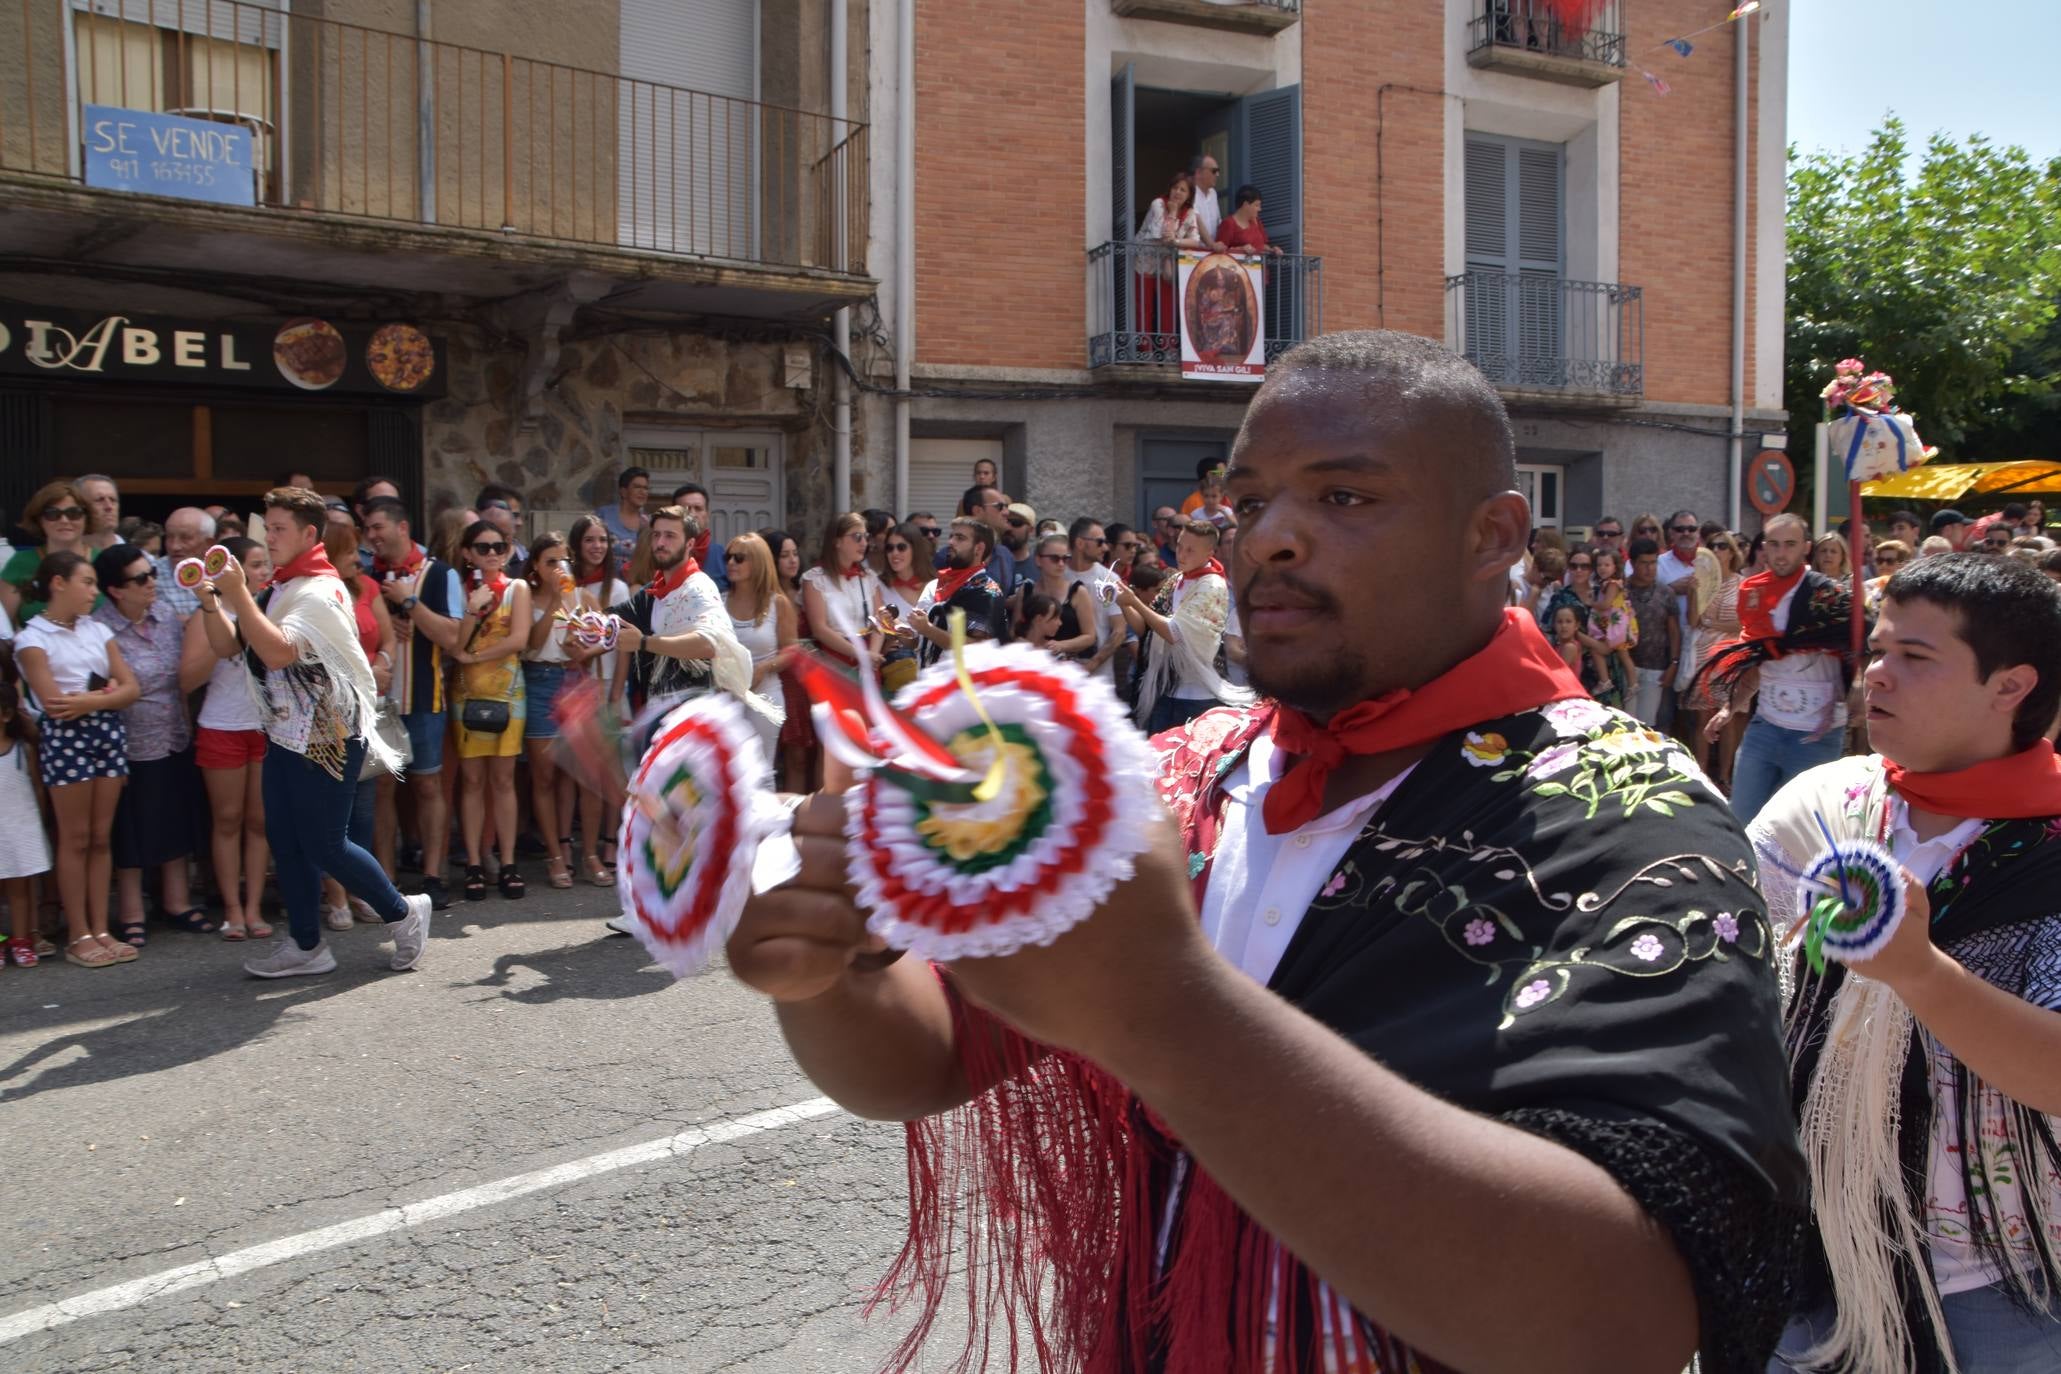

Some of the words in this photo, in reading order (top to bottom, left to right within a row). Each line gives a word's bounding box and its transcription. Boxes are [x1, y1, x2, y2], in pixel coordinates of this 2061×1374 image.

[94, 121, 138, 154] SE
[150, 127, 241, 165] VENDE
[1216, 365, 1234, 374] SAN
